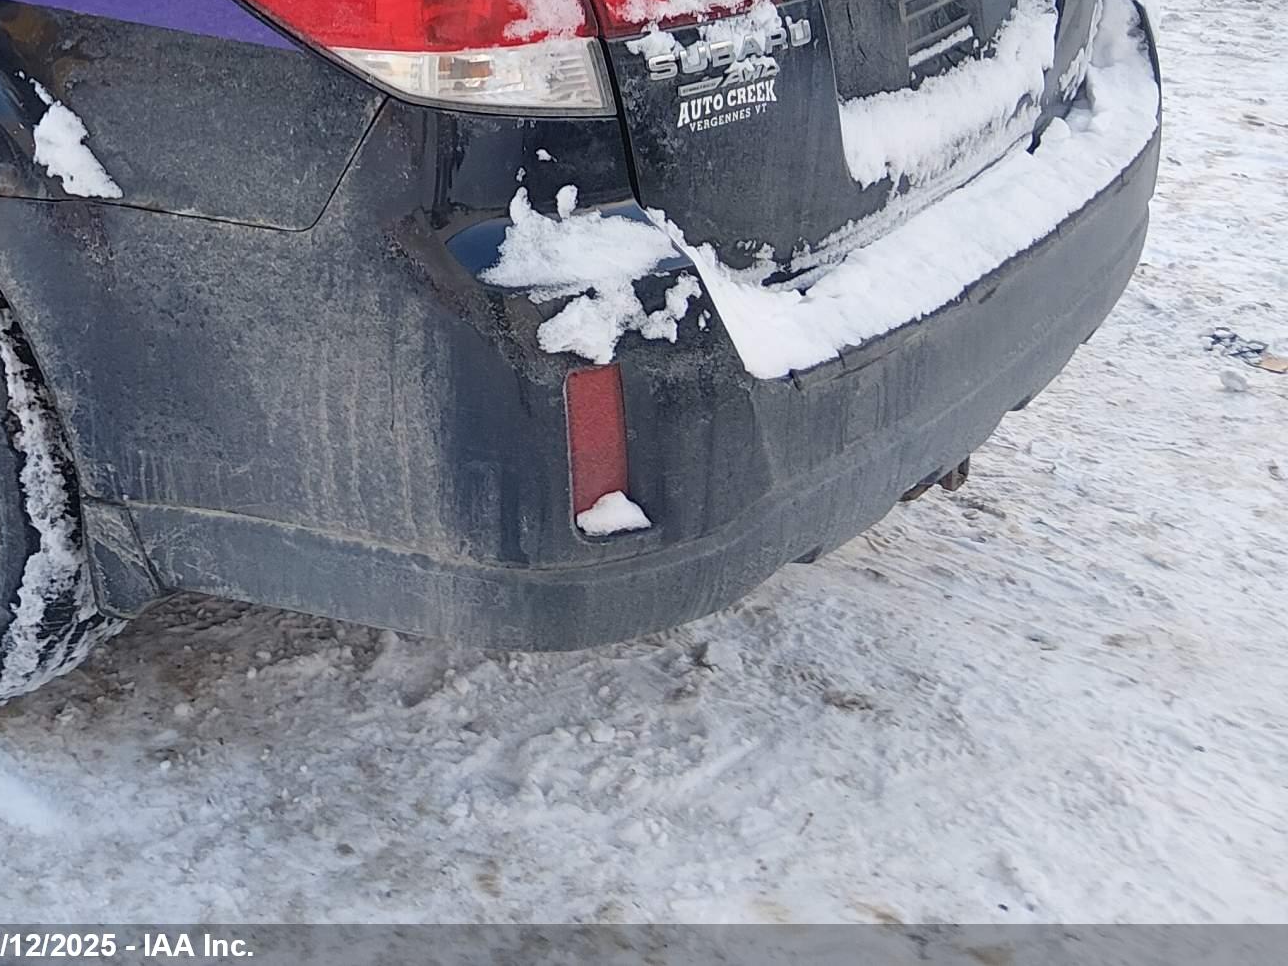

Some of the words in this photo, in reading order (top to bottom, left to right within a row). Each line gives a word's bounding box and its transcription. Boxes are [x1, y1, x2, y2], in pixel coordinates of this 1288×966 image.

[647, 17, 812, 81] SUBARU
[677, 93, 724, 128] AUTO
[727, 79, 777, 107] CREEK
[689, 107, 752, 133] VERGENNES
[755, 102, 768, 115] VT
